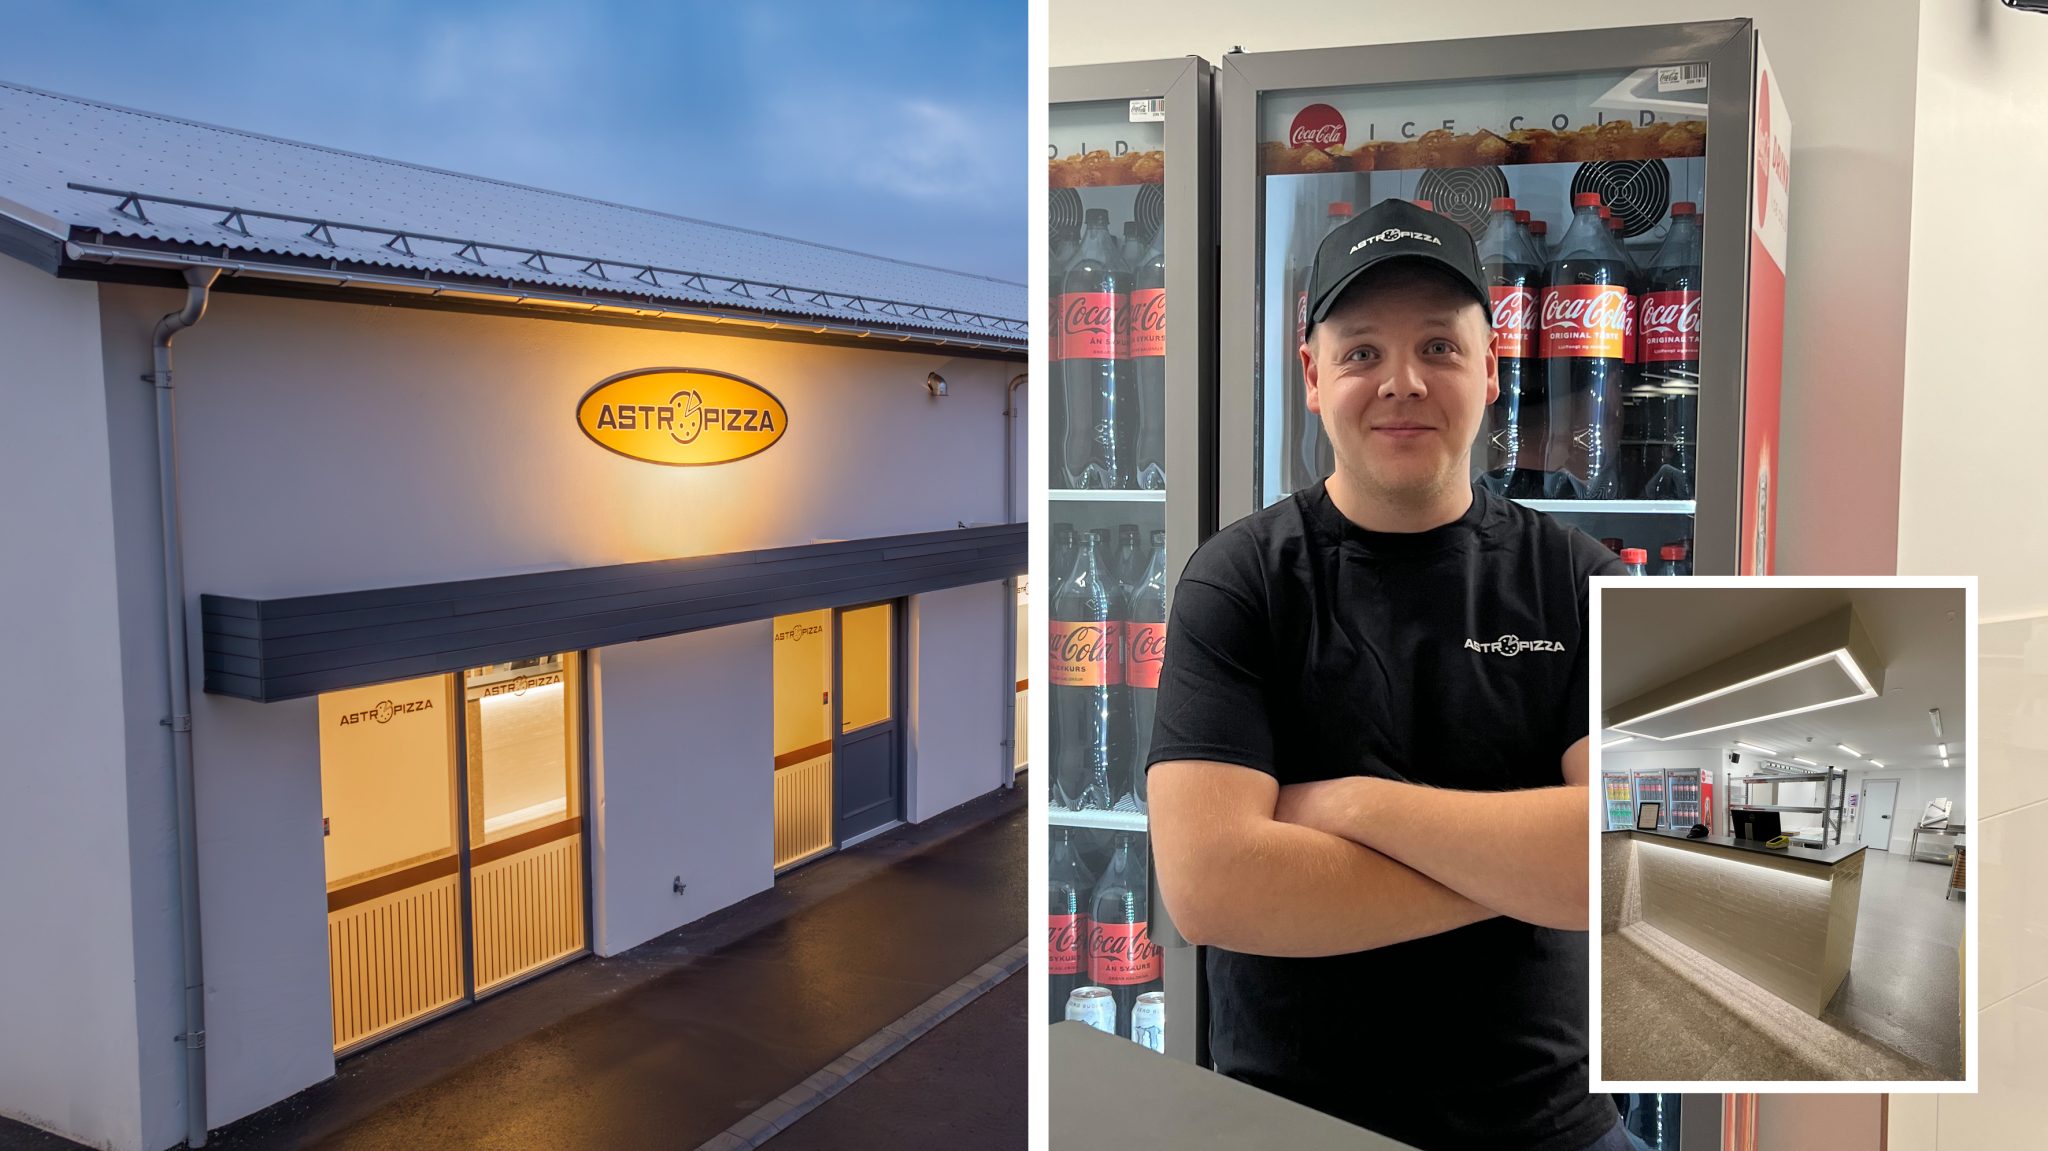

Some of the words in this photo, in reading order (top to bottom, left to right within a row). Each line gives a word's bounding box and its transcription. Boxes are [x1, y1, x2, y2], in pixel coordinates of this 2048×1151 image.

[1292, 124, 1344, 144] Coca-Cola
[1369, 120, 1455, 140] ICE
[1541, 290, 1627, 330] Coca-Cola
[1550, 332, 1592, 340] ORIGINAL
[1647, 336, 1686, 344] ORIGINAL
